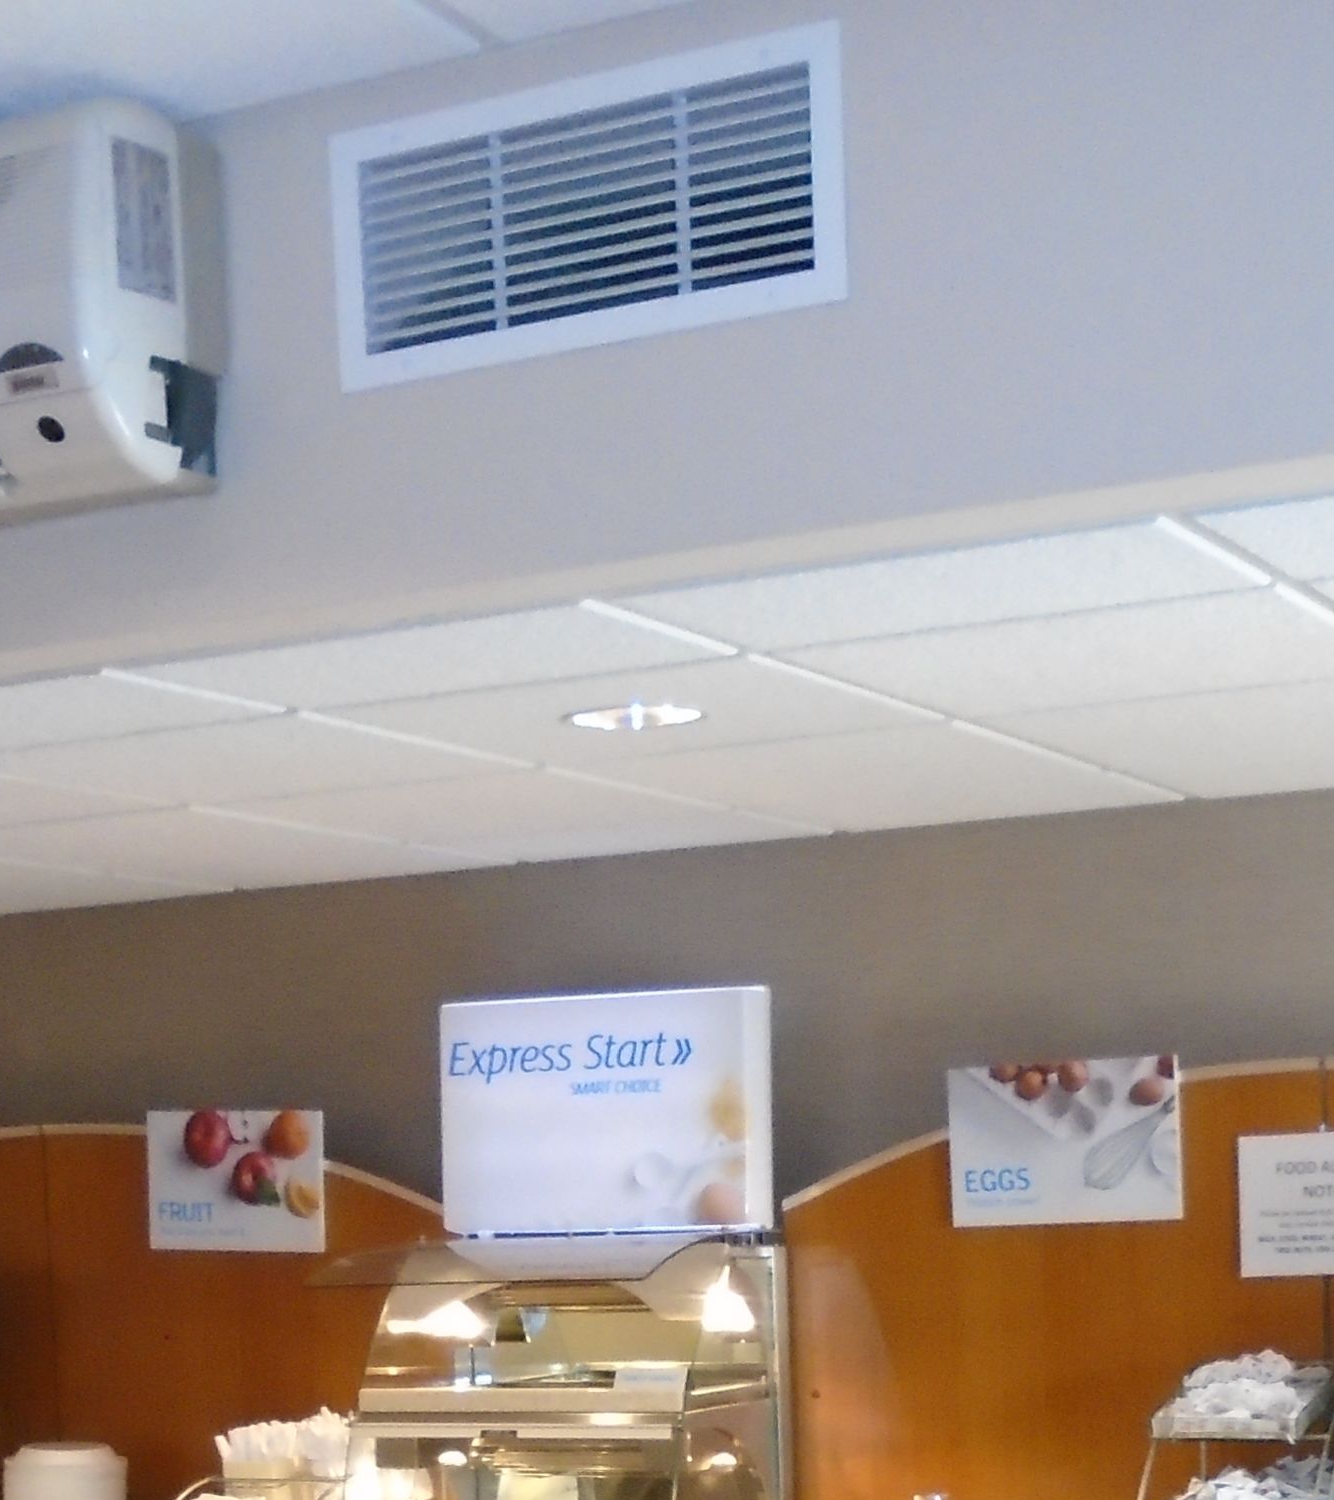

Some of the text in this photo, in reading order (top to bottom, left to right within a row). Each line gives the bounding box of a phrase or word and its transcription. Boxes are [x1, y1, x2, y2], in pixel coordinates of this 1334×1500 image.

[449, 1041, 572, 1084] Express
[1275, 1161, 1317, 1175] FOOD
[964, 1167, 1031, 1193] EGGS
[158, 1202, 213, 1222] FRUIT
